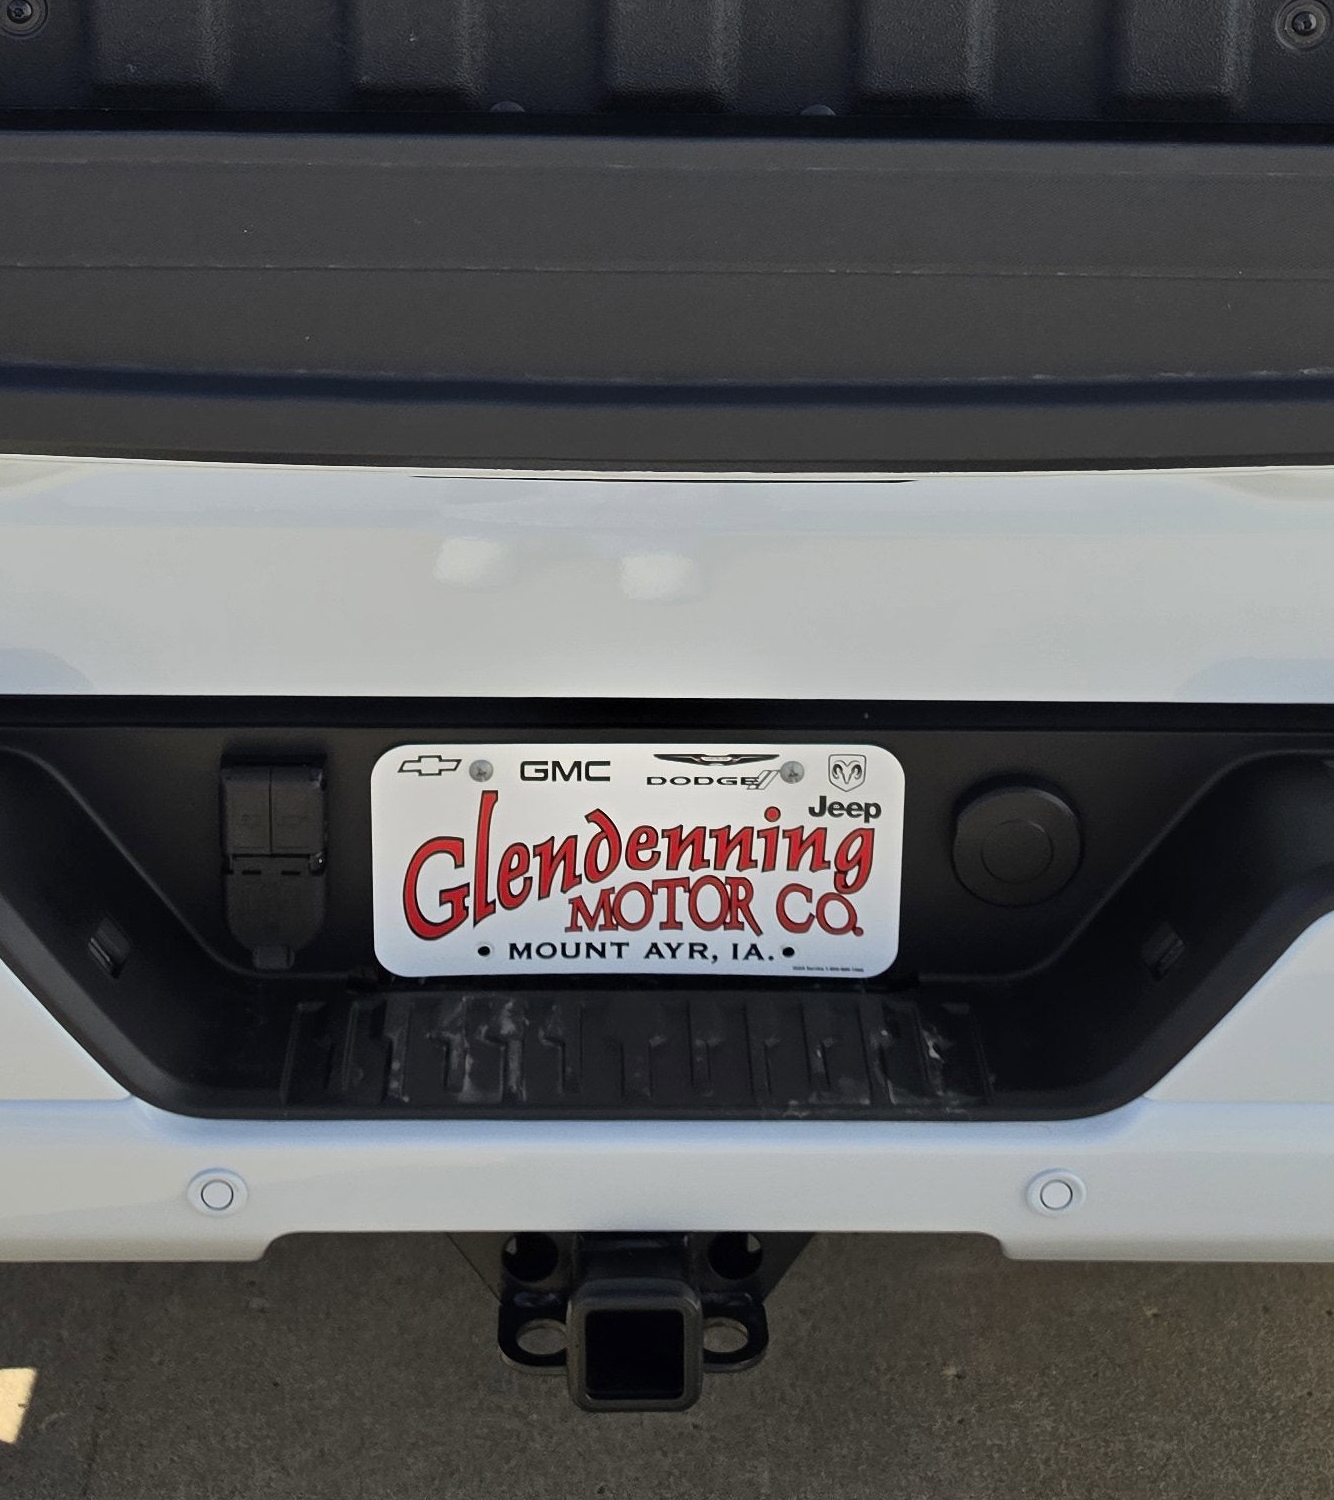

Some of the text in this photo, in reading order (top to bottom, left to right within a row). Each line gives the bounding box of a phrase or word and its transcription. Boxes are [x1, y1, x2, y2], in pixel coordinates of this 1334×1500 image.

[520, 760, 611, 782] GMC
[646, 775, 758, 786] DODGE
[808, 795, 882, 823] Jeep
[402, 790, 876, 941] Glendenning
[564, 875, 864, 937] MOTOR CO.
[508, 941, 630, 961] MOUNT
[643, 942, 719, 963] AYR,
